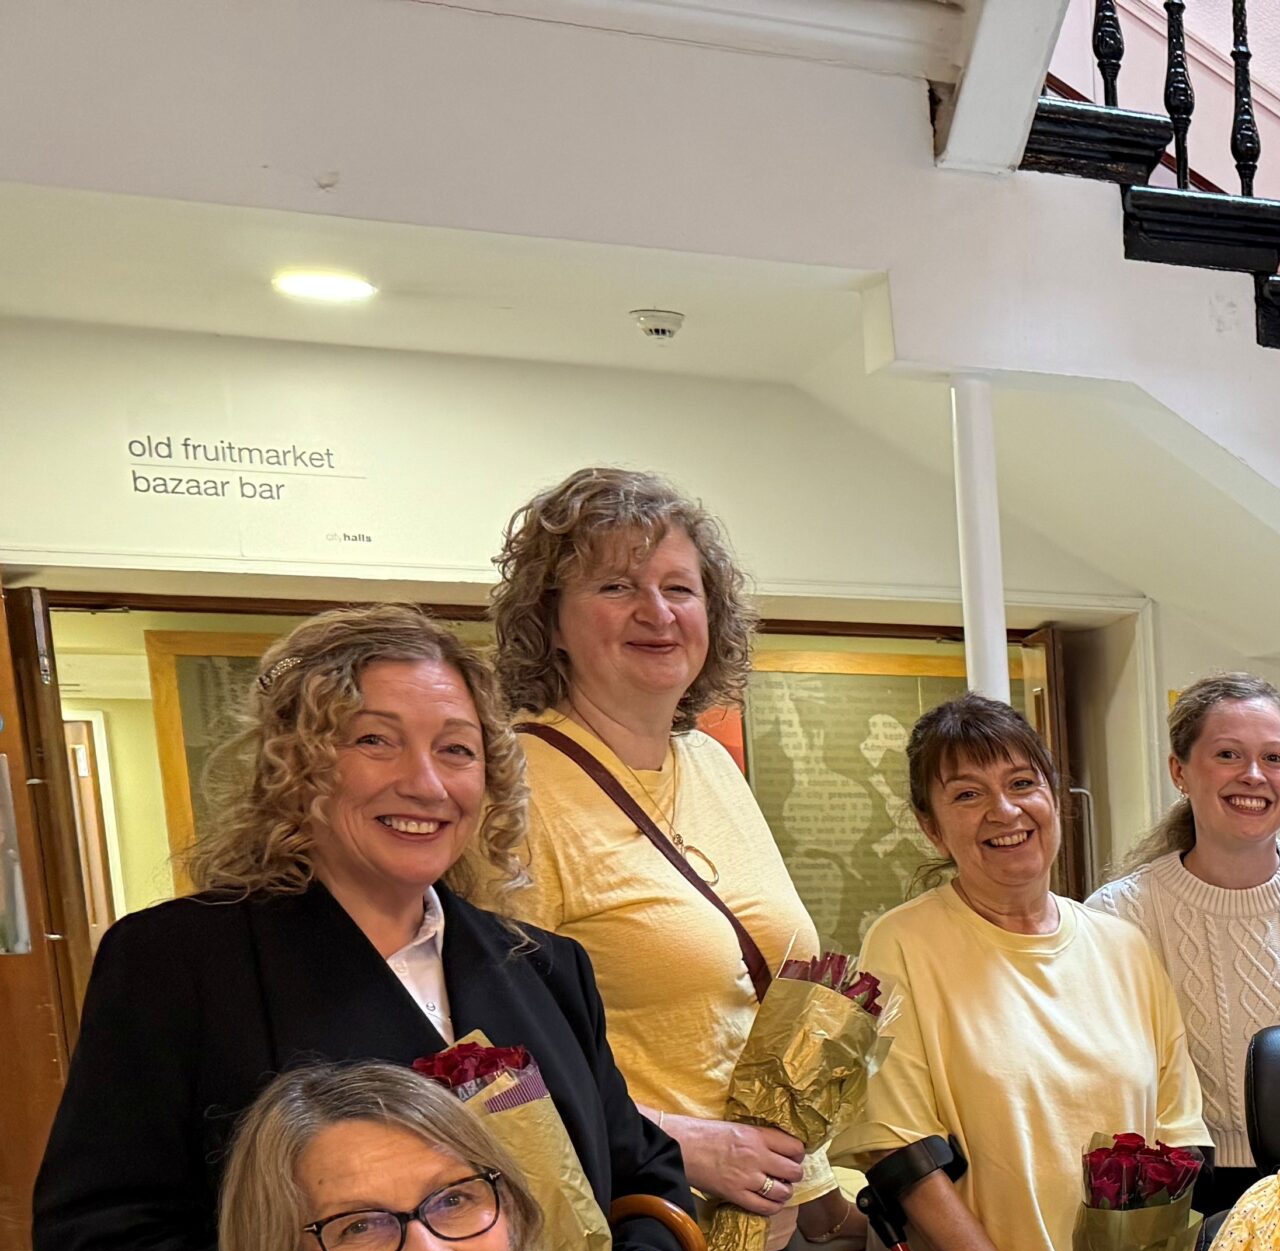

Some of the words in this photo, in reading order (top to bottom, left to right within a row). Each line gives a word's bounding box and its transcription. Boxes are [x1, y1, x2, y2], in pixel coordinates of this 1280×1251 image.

[128, 435, 172, 459] old
[181, 437, 335, 469] fruitmarket
[132, 470, 230, 497] bazaar
[239, 476, 285, 500] bar
